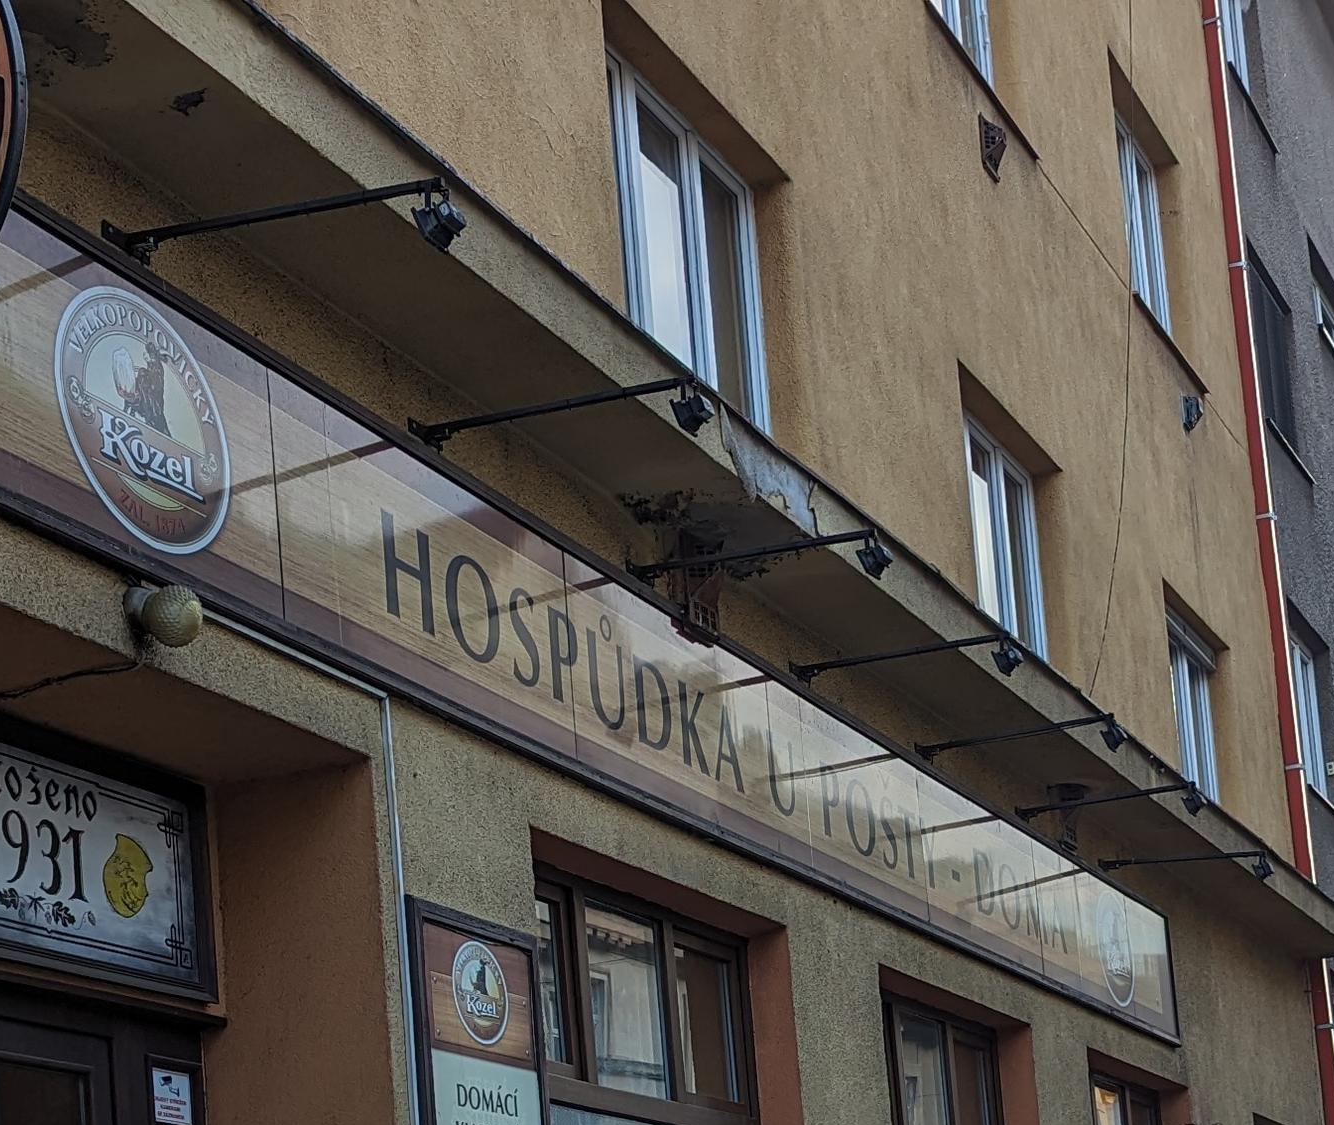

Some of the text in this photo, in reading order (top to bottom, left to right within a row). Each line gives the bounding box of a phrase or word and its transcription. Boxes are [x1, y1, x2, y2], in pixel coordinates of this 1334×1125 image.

[98, 408, 204, 502] Kozel
[380, 508, 746, 795] HOSPŮDKA
[768, 720, 796, 817] U
[820, 761, 937, 889] POŠTY
[466, 994, 500, 1018] Kozel
[456, 1083, 519, 1118] DOMÁCÍ
